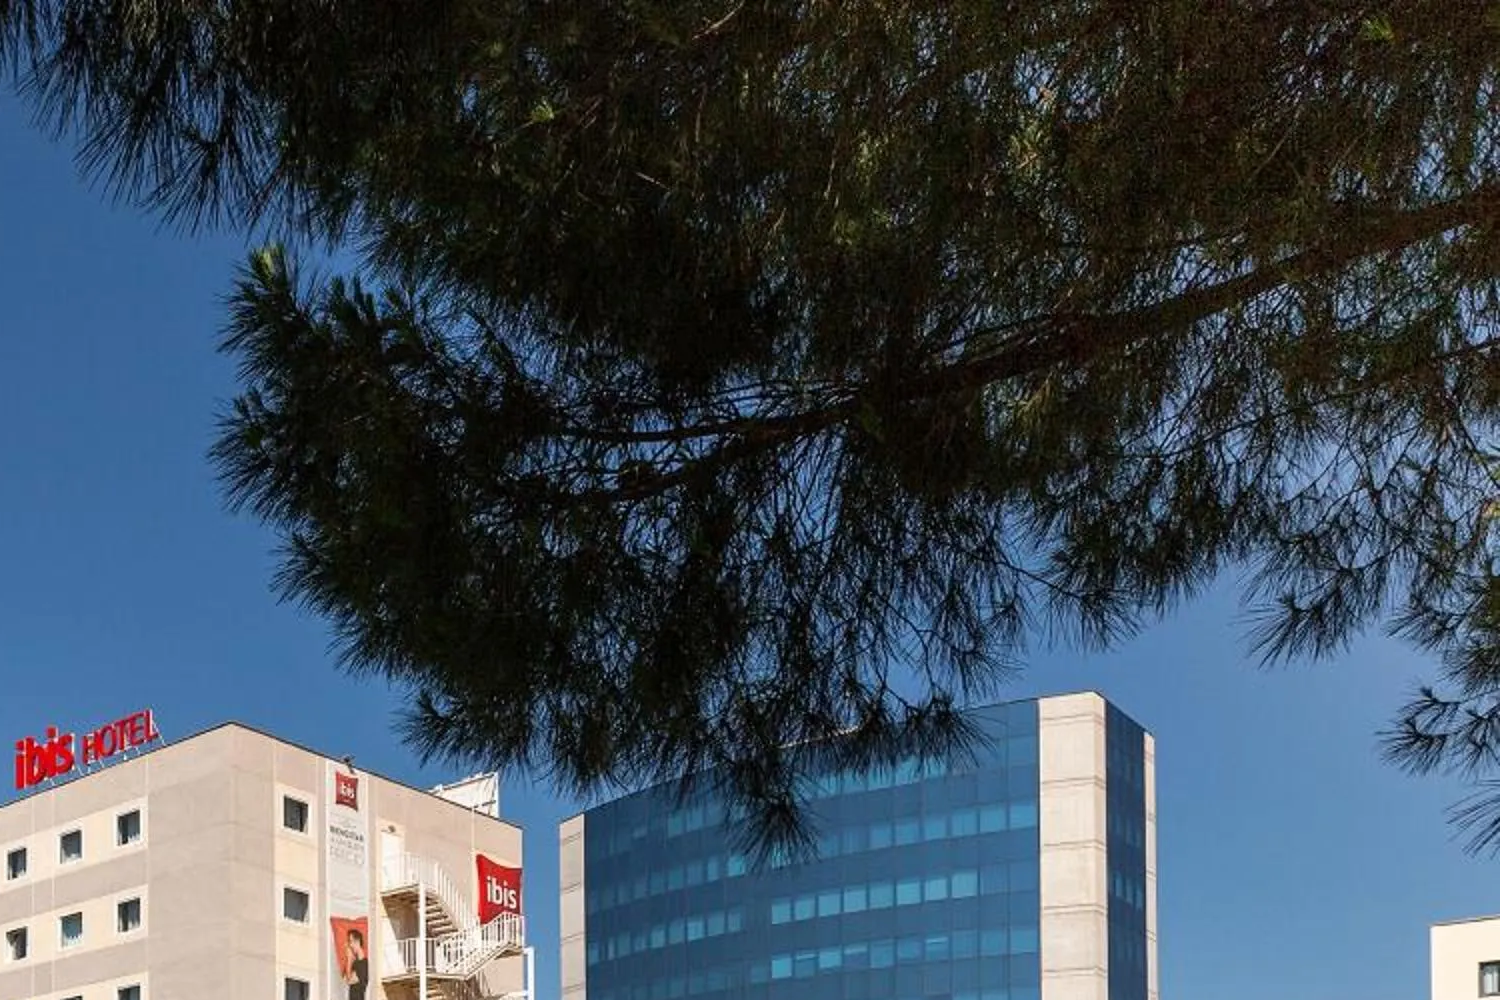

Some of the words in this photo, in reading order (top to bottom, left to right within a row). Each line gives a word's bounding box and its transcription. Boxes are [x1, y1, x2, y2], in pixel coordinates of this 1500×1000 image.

[14, 725, 74, 790] ibis
[81, 708, 159, 765] HOTEL
[486, 875, 517, 909] ibis
